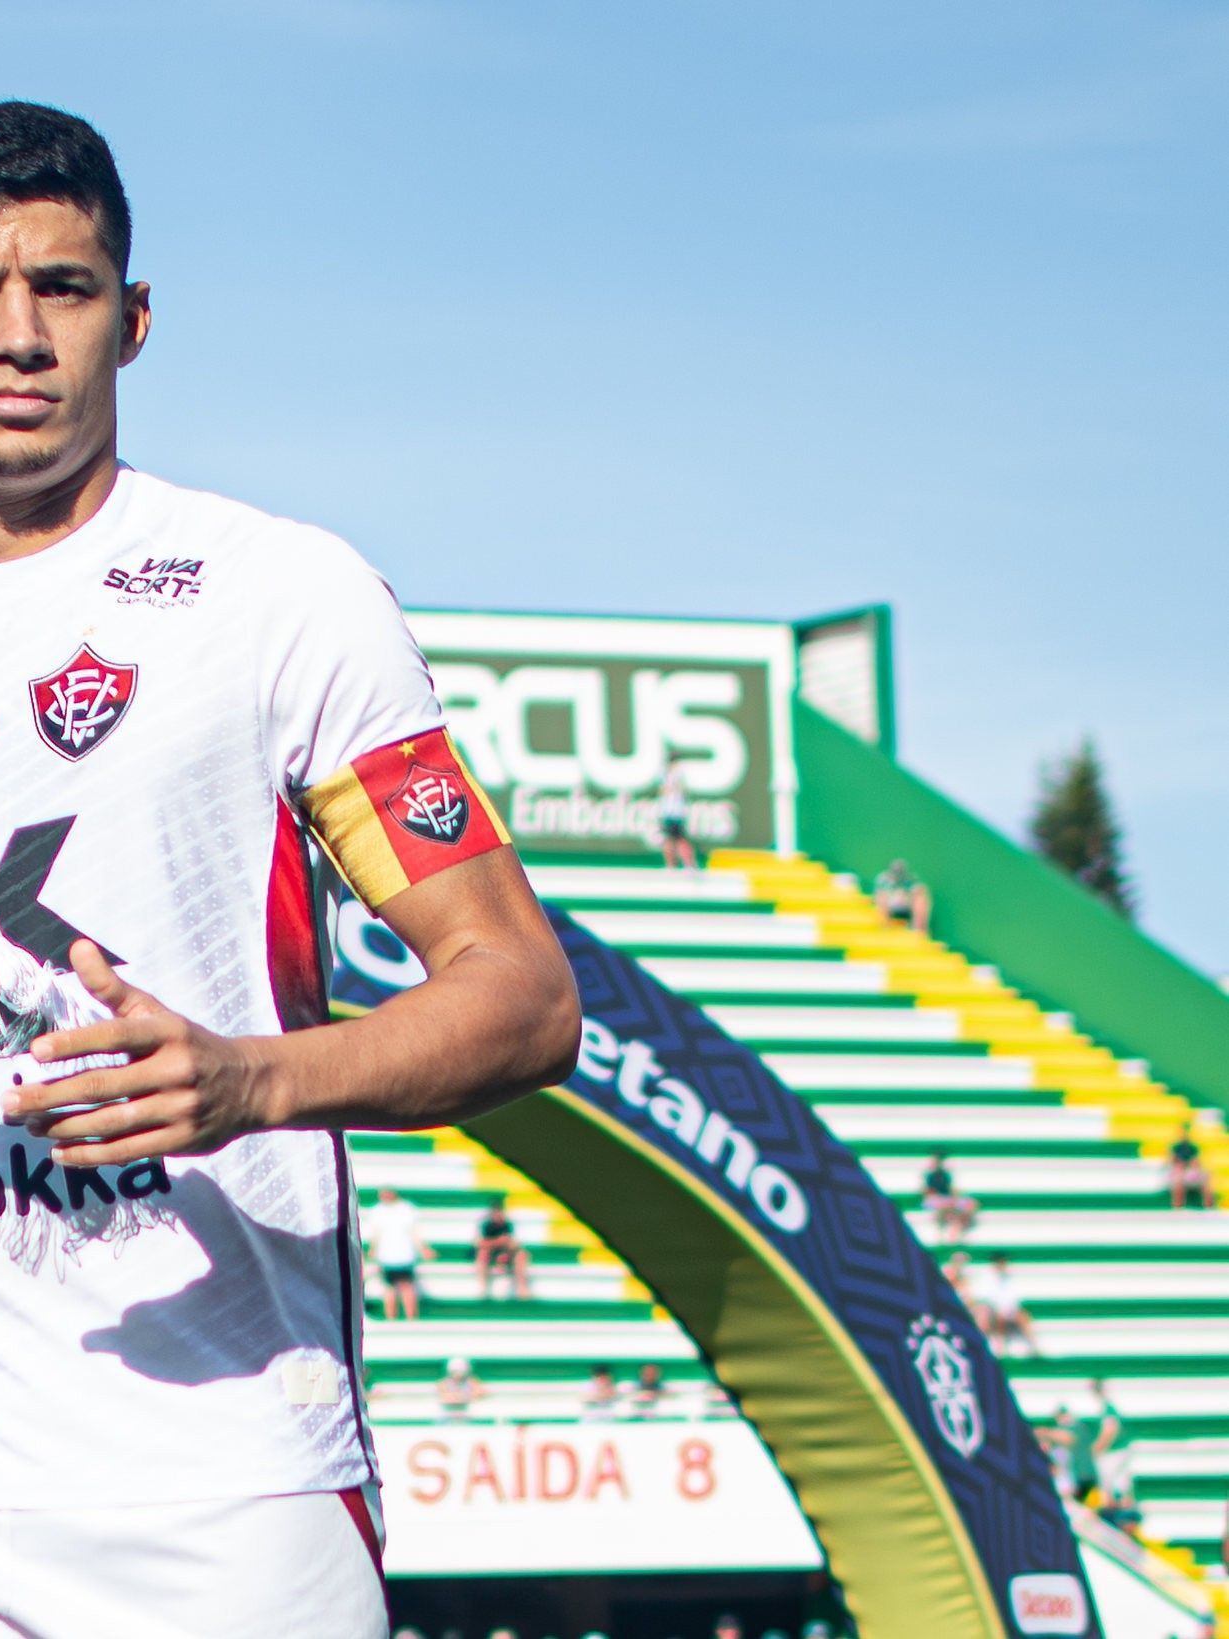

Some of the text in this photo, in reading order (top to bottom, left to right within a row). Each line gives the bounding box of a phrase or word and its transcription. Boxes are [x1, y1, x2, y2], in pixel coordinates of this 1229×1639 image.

[422, 661, 749, 794] RCUS
[577, 1016, 810, 1234] etano
[406, 1423, 718, 1505] SAÍDA 8
